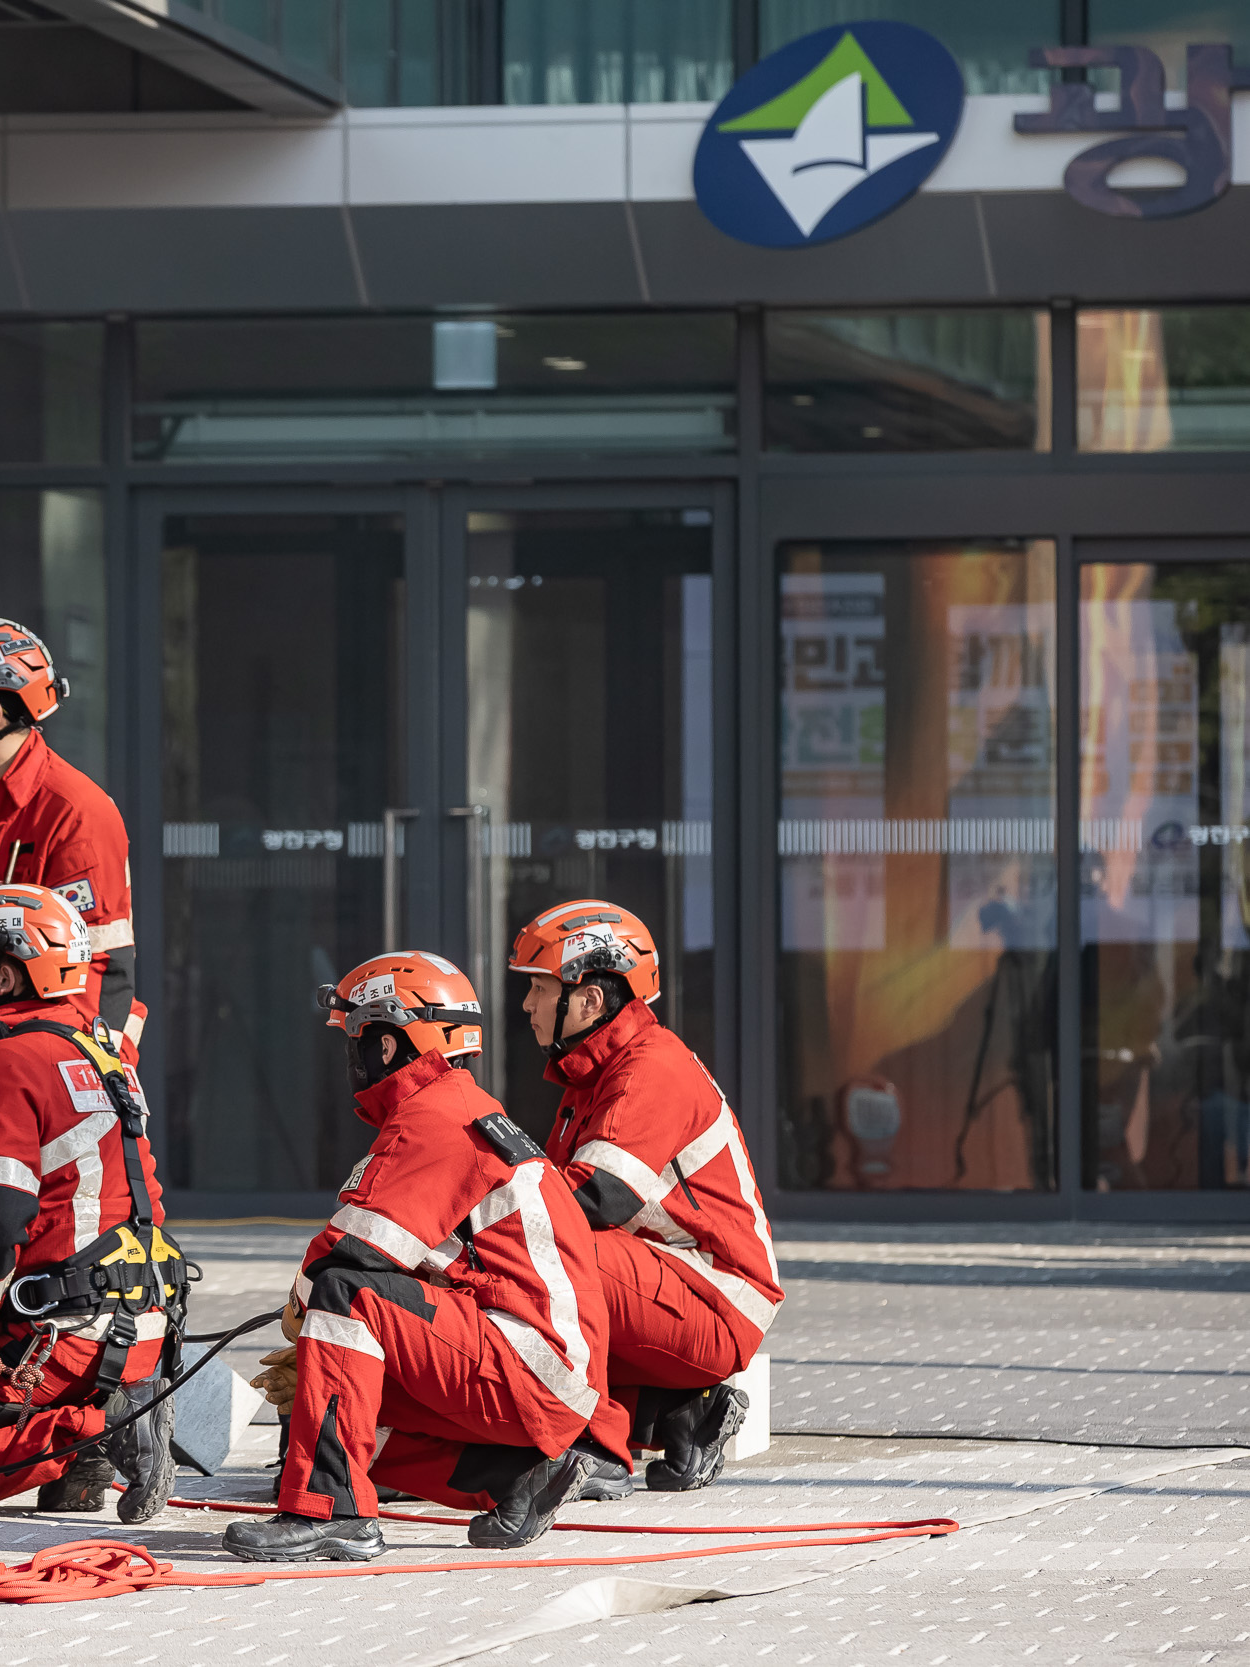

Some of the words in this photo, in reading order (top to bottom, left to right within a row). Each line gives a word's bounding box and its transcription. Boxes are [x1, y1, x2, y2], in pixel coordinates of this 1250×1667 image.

[1014, 44, 1250, 221] 광
[567, 931, 585, 947] 119
[577, 933, 614, 951] 구조대
[351, 981, 368, 999] 119
[358, 984, 394, 1004] 구조대
